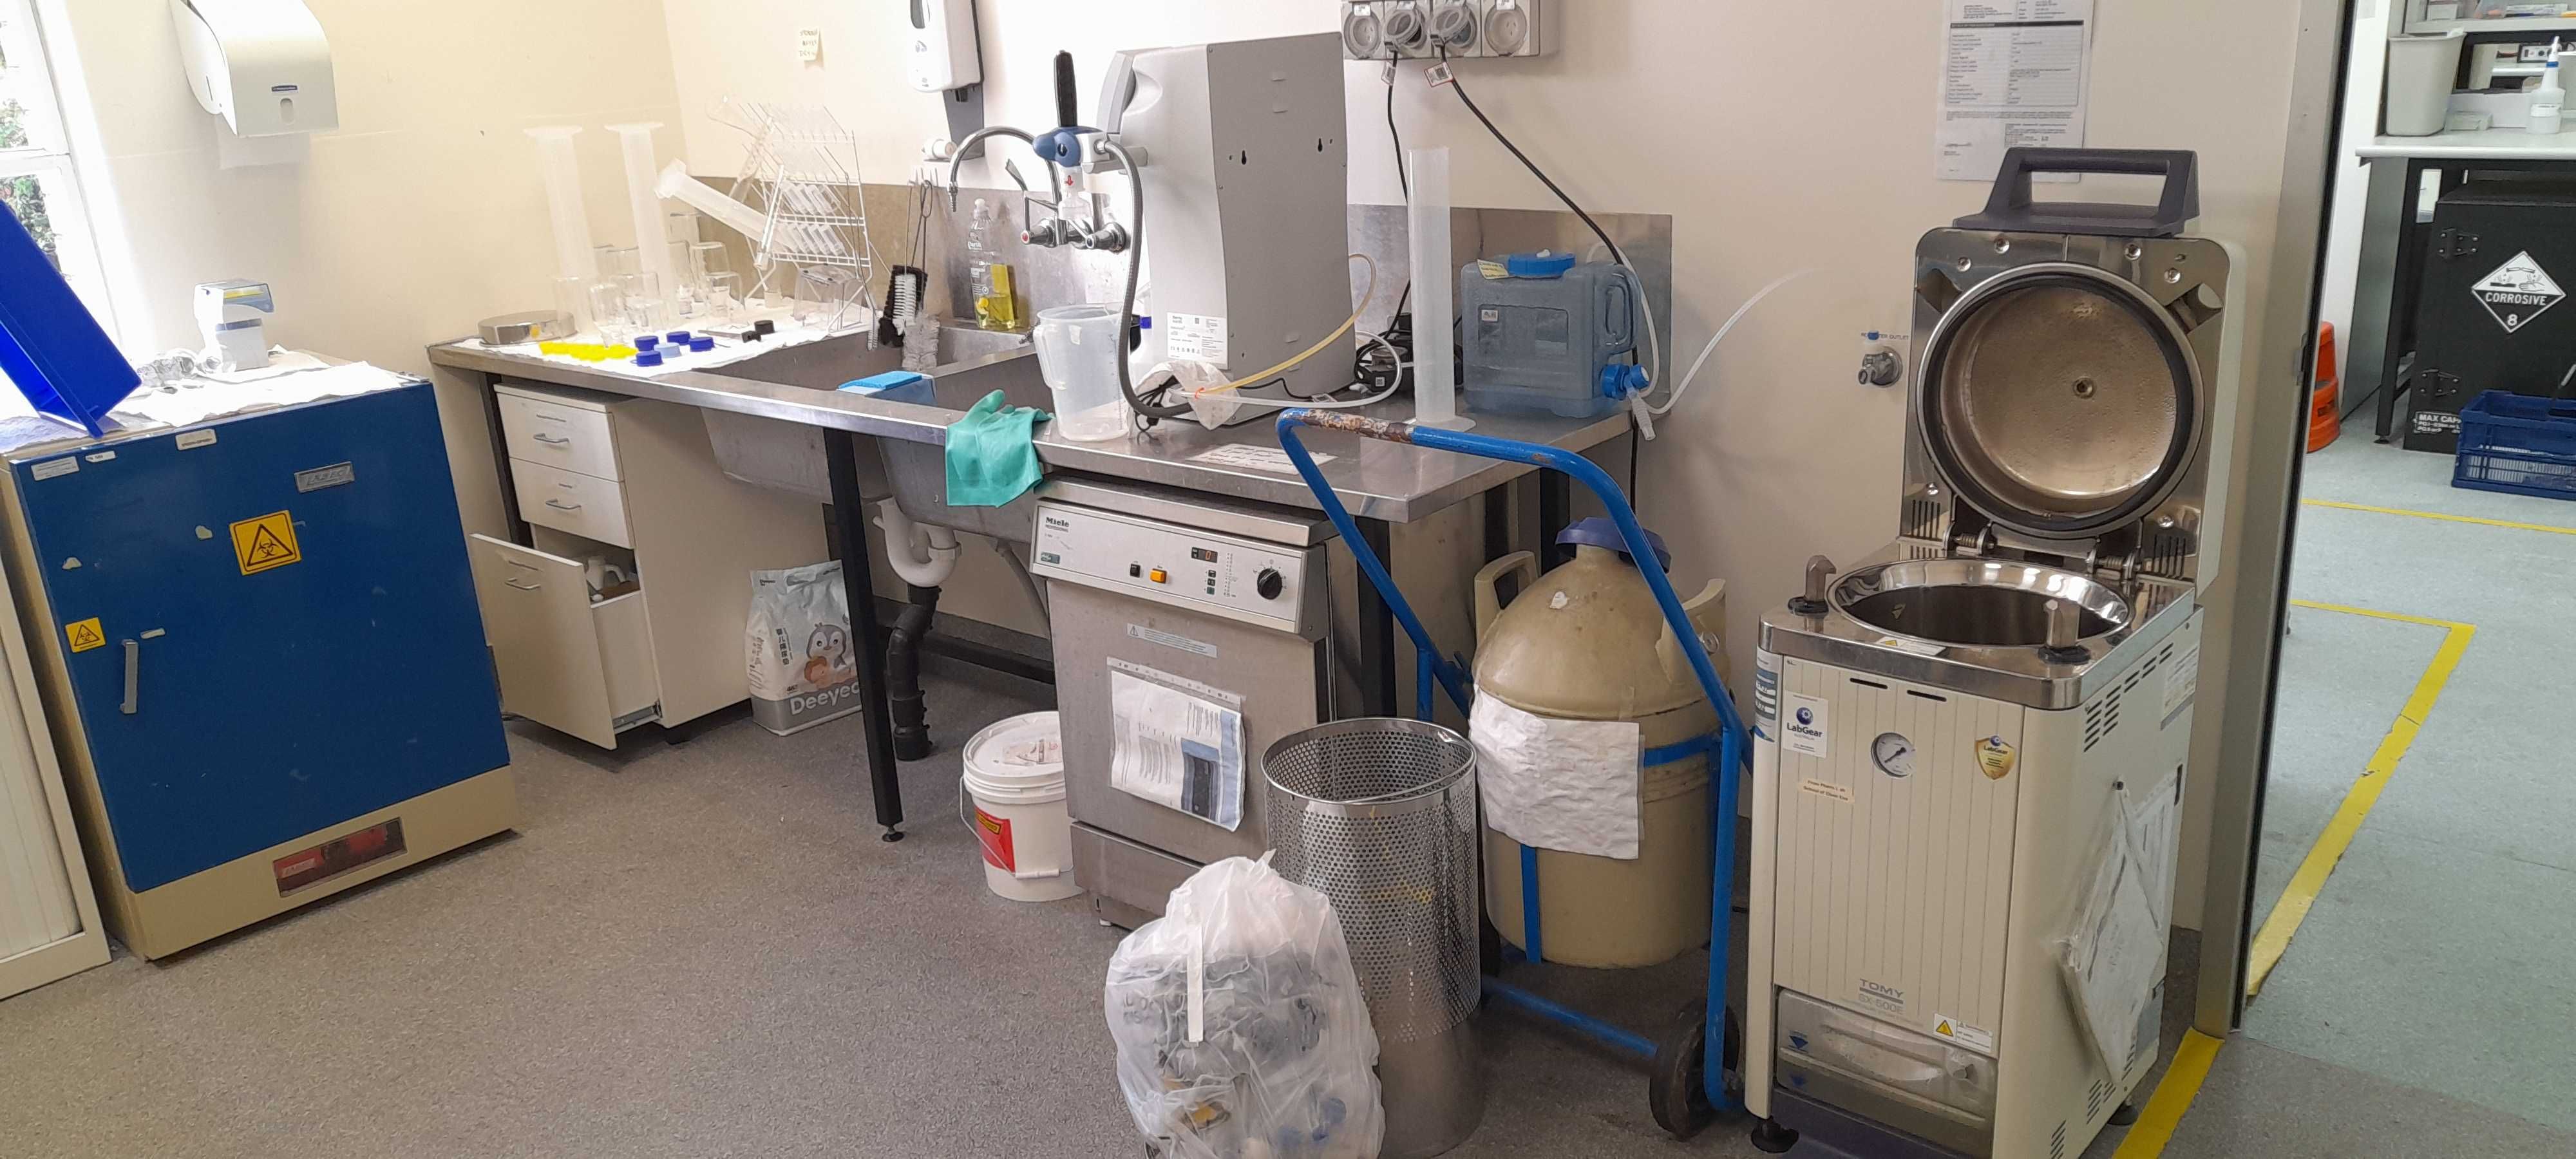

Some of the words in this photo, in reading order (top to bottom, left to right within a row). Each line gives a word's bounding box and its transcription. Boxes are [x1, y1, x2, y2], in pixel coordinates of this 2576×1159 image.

[2486, 292, 2547, 306] CORROSIVE
[2507, 314, 2518, 326] 8
[1045, 516, 1070, 528] Miele
[1786, 722, 1823, 738] LabGear
[1984, 744, 2009, 755] LabGear
[1803, 785, 1819, 793] School
[1859, 978, 1904, 998] TOMY
